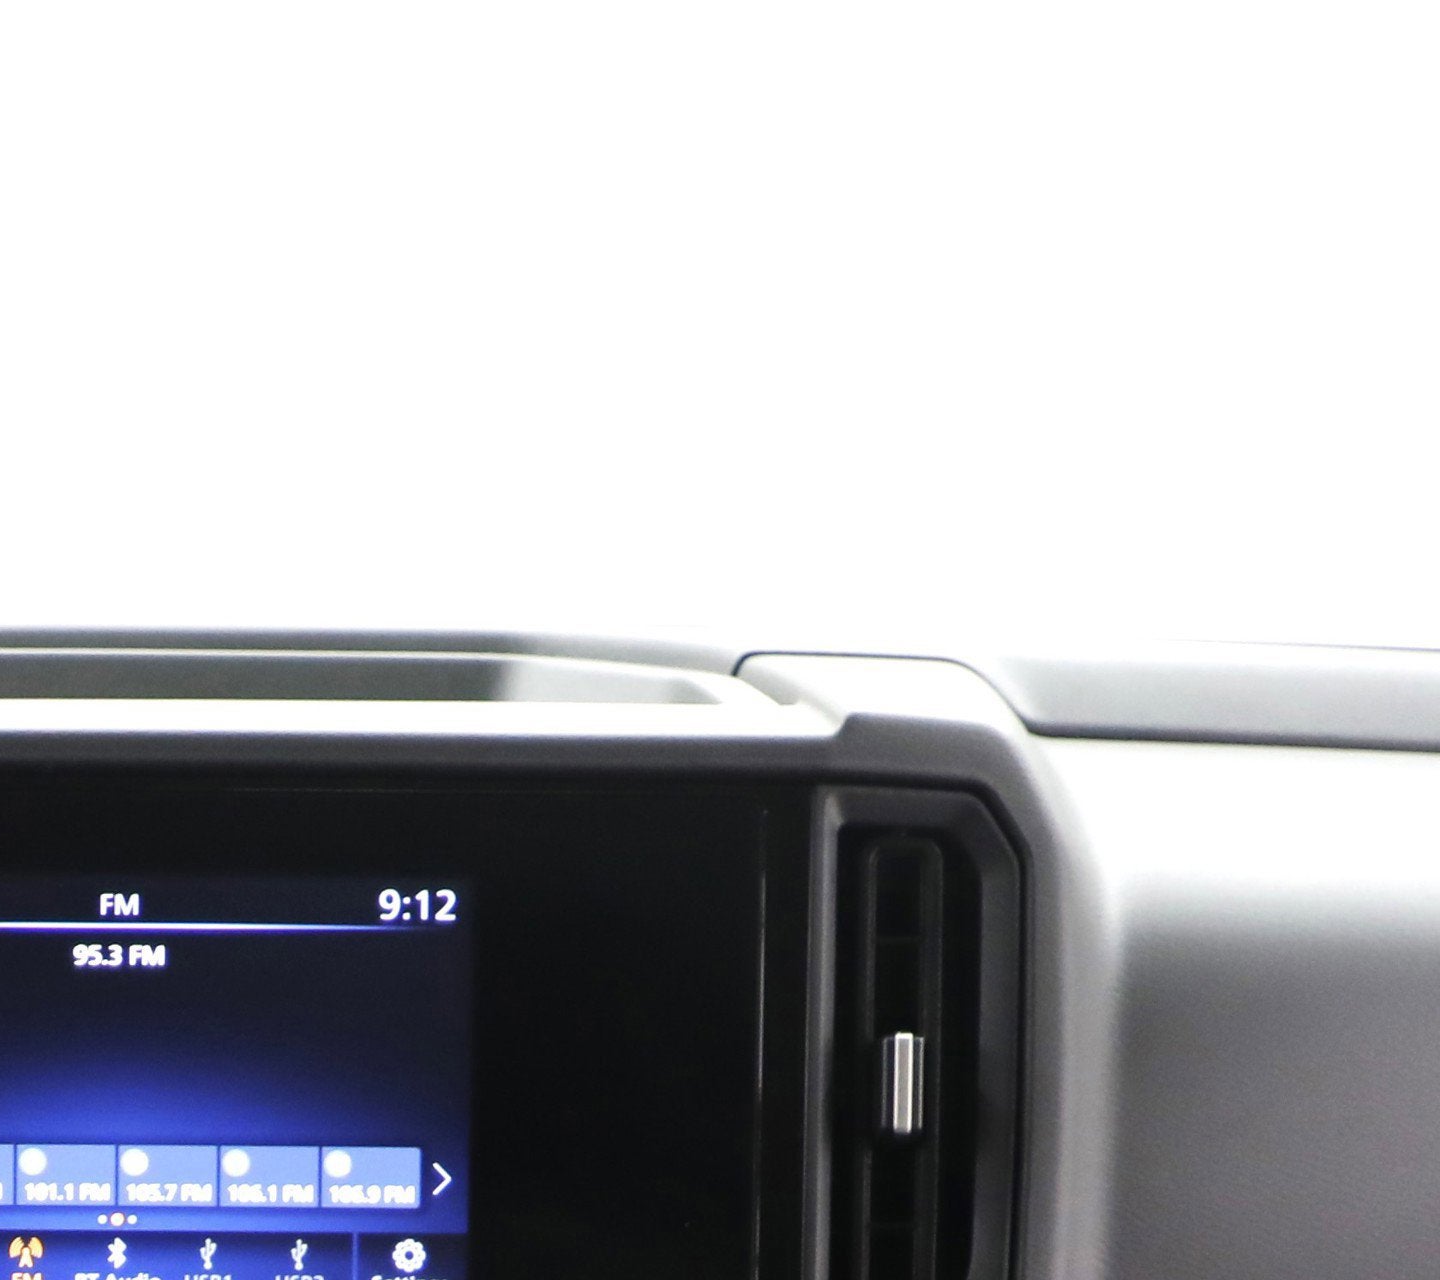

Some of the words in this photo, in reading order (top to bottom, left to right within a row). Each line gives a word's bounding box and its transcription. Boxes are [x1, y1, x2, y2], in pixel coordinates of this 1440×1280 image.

[99, 893, 140, 917] FM
[378, 888, 458, 922] 9:12
[73, 945, 123, 967] 95.3
[129, 946, 166, 968] FM
[79, 1182, 111, 1202] FM
[181, 1184, 213, 1203] FM
[282, 1184, 315, 1203] FM
[384, 1185, 416, 1204] FM
